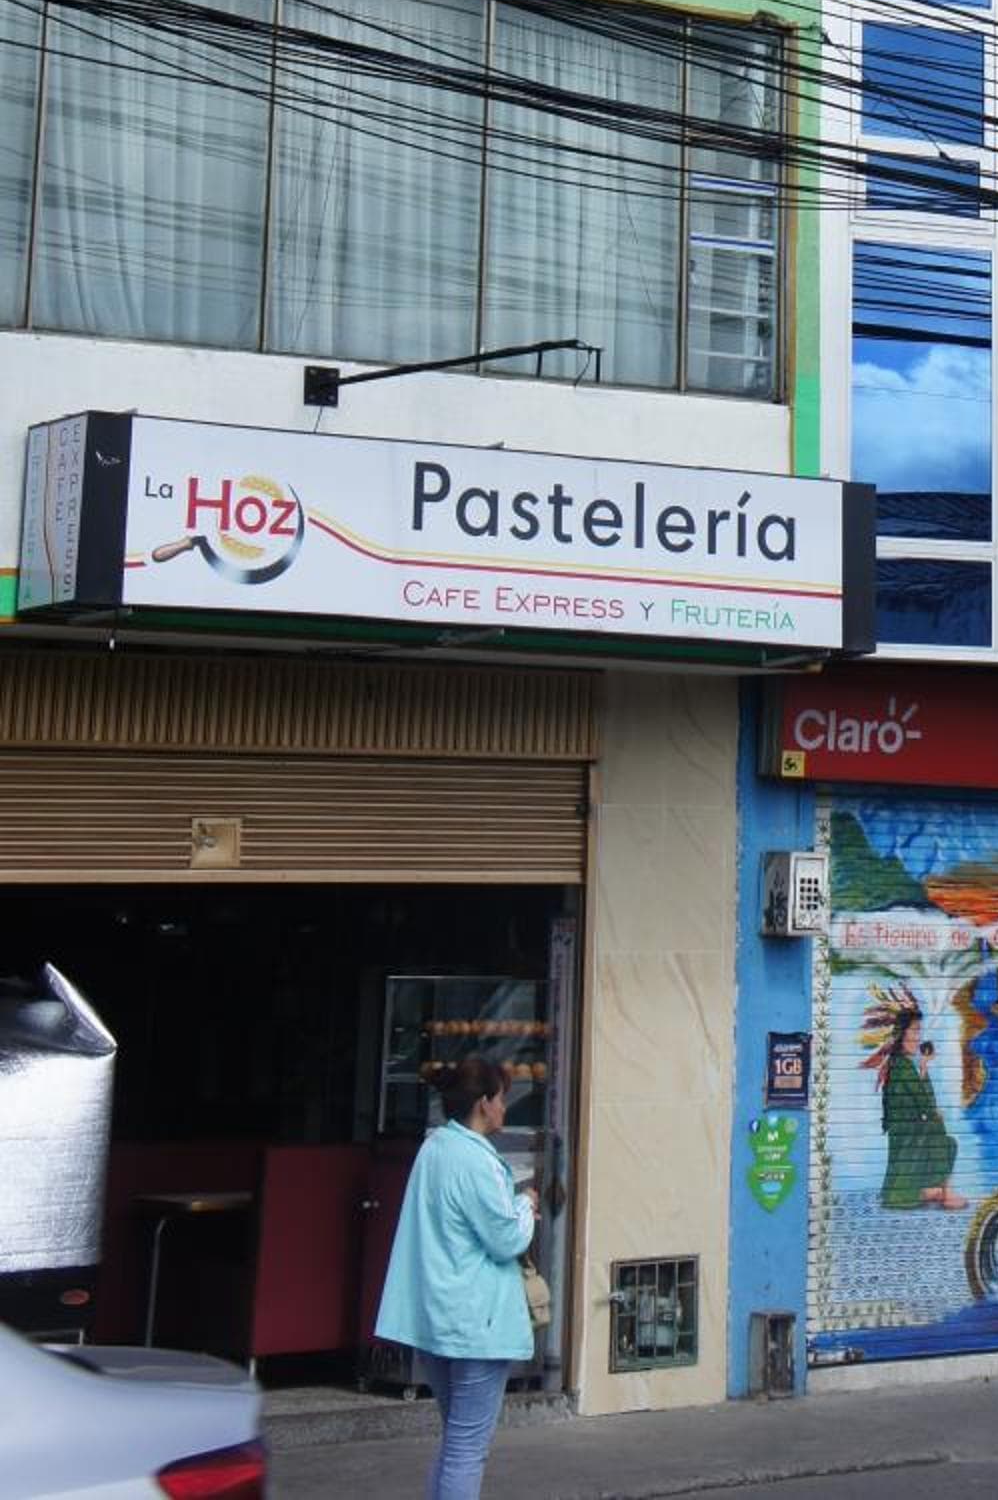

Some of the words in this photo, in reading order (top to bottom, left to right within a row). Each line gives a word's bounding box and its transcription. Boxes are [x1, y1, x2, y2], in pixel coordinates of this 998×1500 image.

[144, 476, 173, 499] La
[186, 477, 298, 536] Hoz
[411, 461, 797, 562] Pastelería
[495, 586, 625, 620] EXPRESS
[794, 703, 915, 754] Claro
